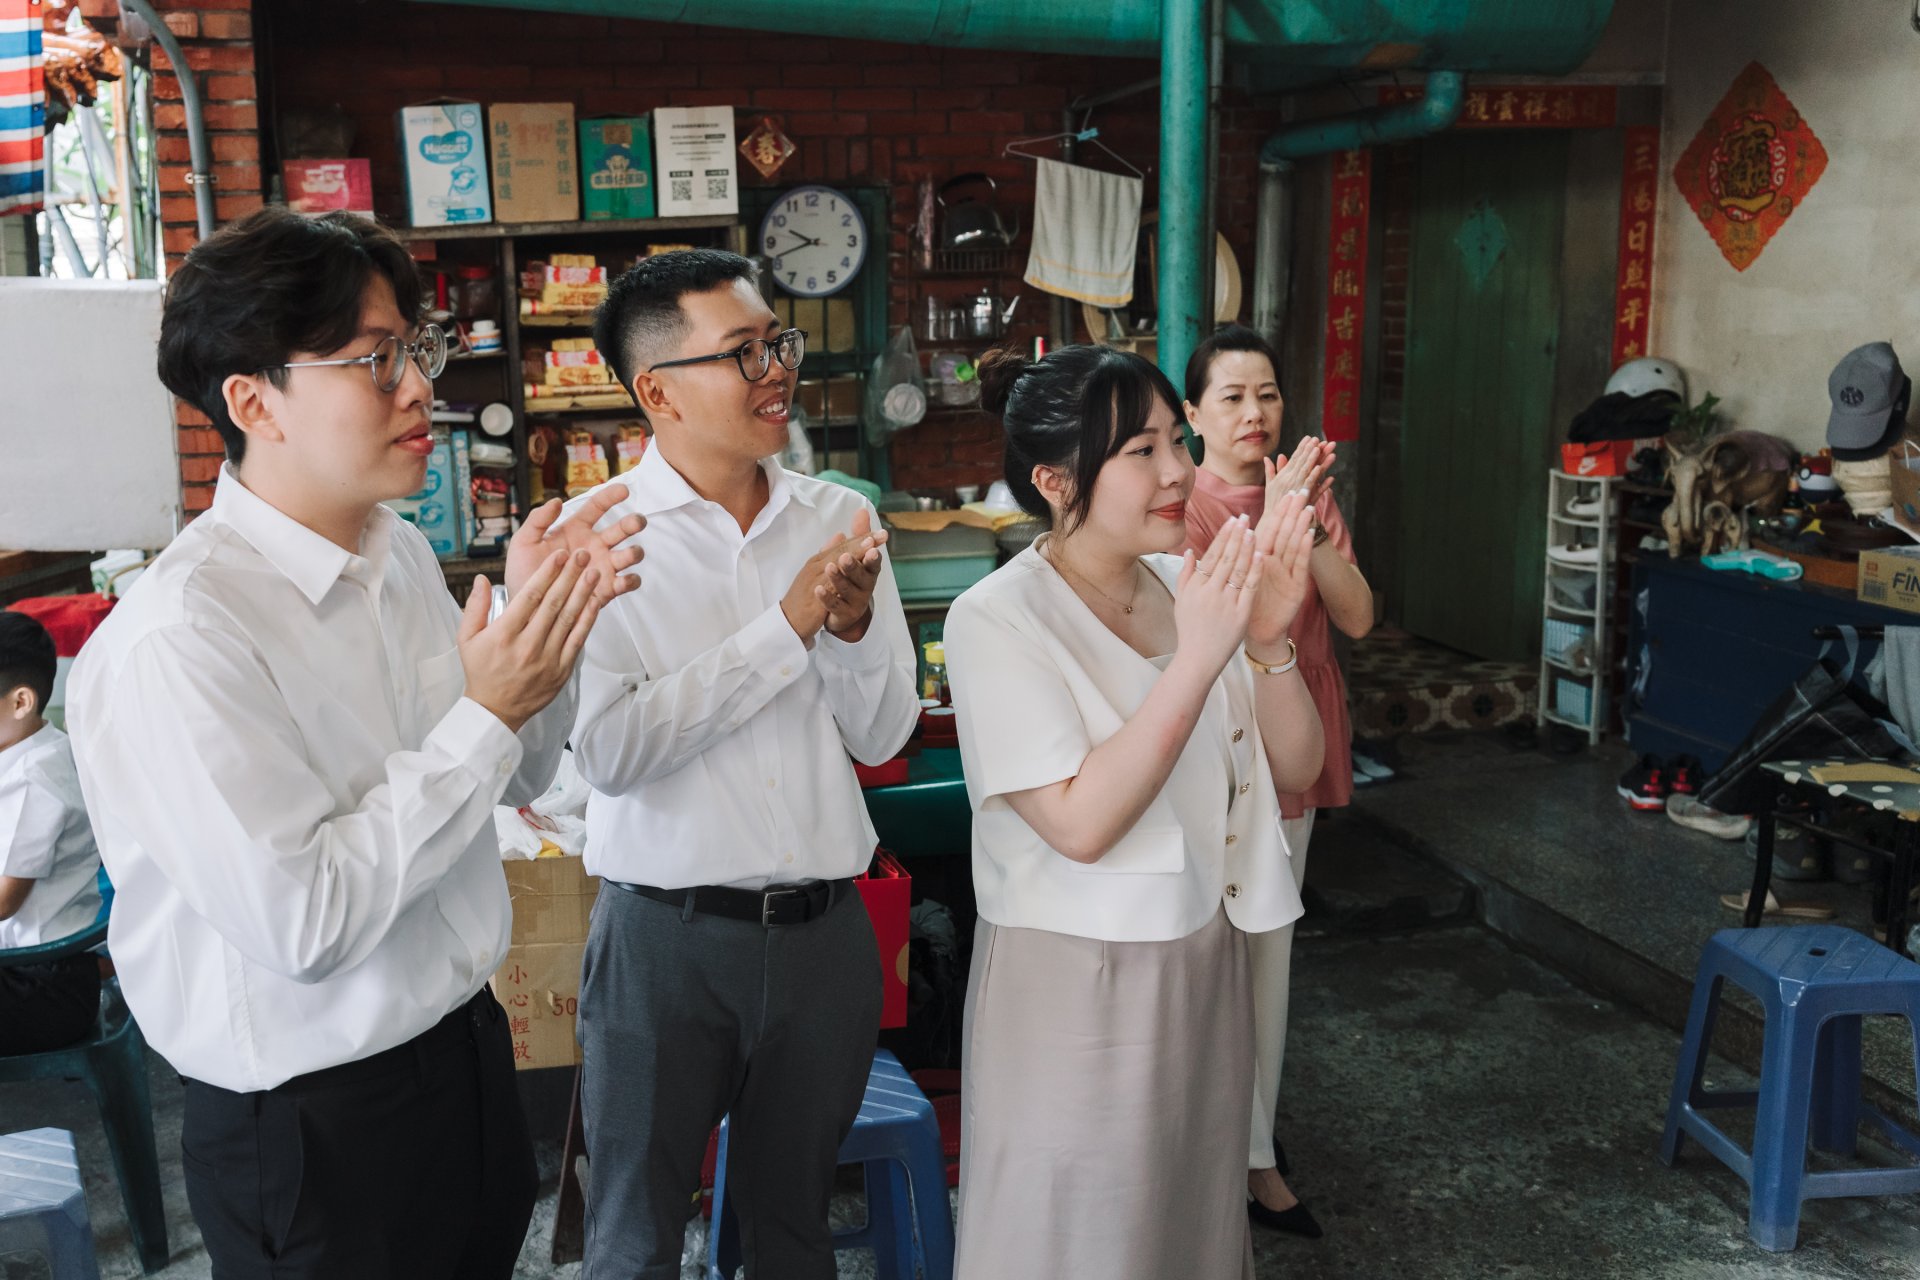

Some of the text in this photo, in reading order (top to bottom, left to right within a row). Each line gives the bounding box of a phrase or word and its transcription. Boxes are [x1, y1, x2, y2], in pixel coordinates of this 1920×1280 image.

[755, 132, 782, 165] 春
[786, 200, 798, 213] 11
[805, 194, 819, 207] 12
[829, 199, 836, 211] 1
[771, 215, 787, 228] 10
[841, 214, 852, 227] 2
[766, 236, 777, 249] 9
[847, 235, 858, 248] 3
[840, 256, 850, 268] 4
[787, 272, 797, 285] 7
[807, 277, 817, 290] 6
[827, 271, 836, 283] 5
[507, 964, 532, 1061] 小心輕放
